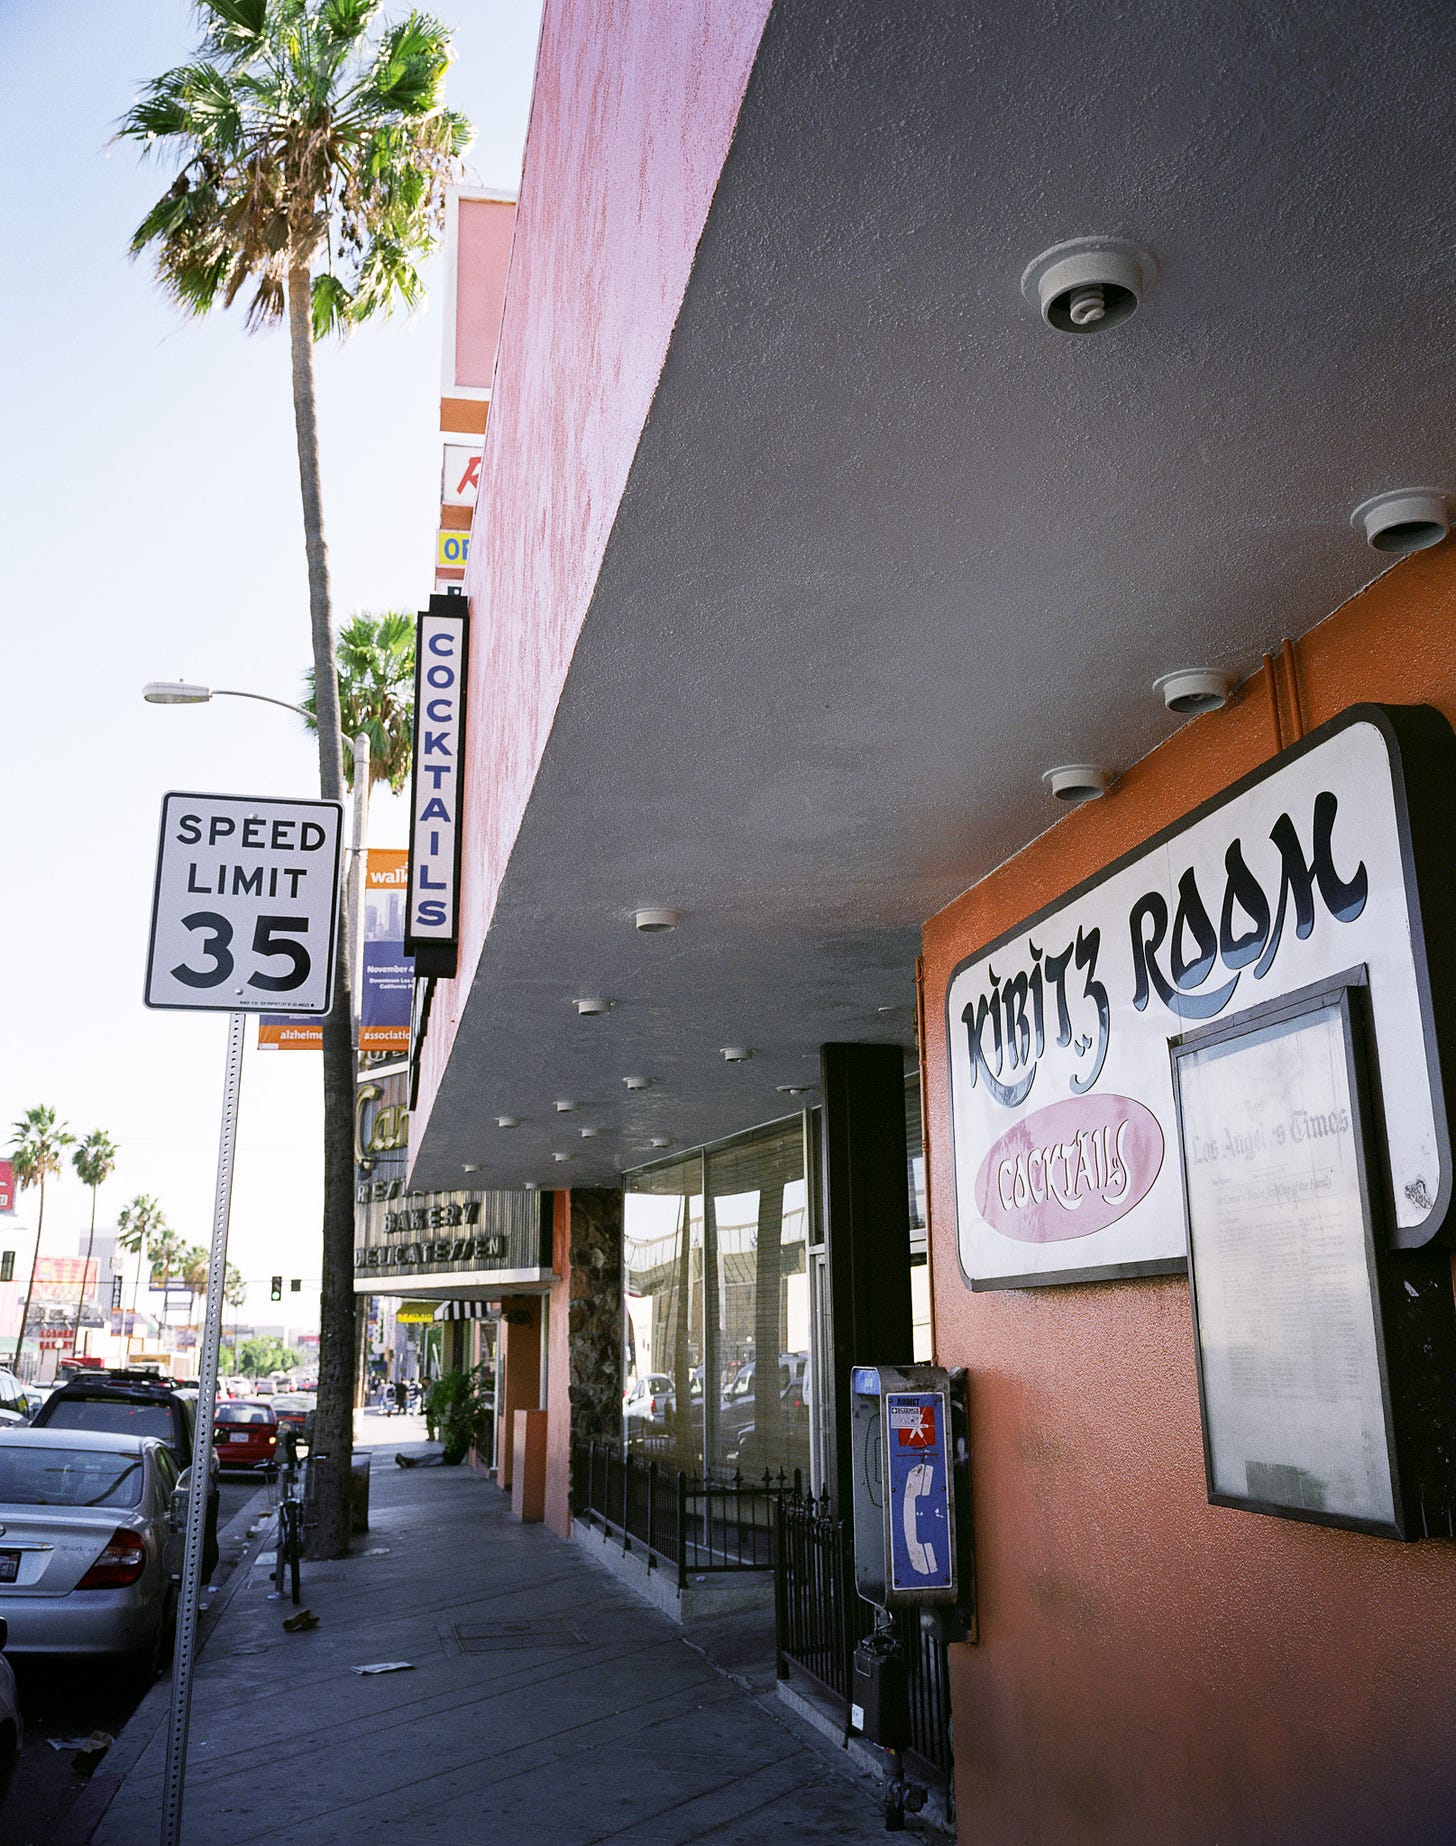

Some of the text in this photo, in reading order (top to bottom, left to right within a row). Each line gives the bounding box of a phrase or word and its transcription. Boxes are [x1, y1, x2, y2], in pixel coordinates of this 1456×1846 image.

[416, 632, 455, 927] COCKTAILS
[176, 814, 326, 852] SPEED
[187, 862, 308, 899] LIMIT
[1129, 791, 1368, 1020] ROOM
[170, 911, 312, 992] 35
[367, 965, 407, 974] November
[1192, 1135, 1220, 1165] Los
[1290, 1107, 1349, 1144] Times
[996, 1119, 1131, 1212] COCKTAILS
[384, 1202, 478, 1233] BAKERY
[354, 1236, 503, 1268] DELICATESSEN
